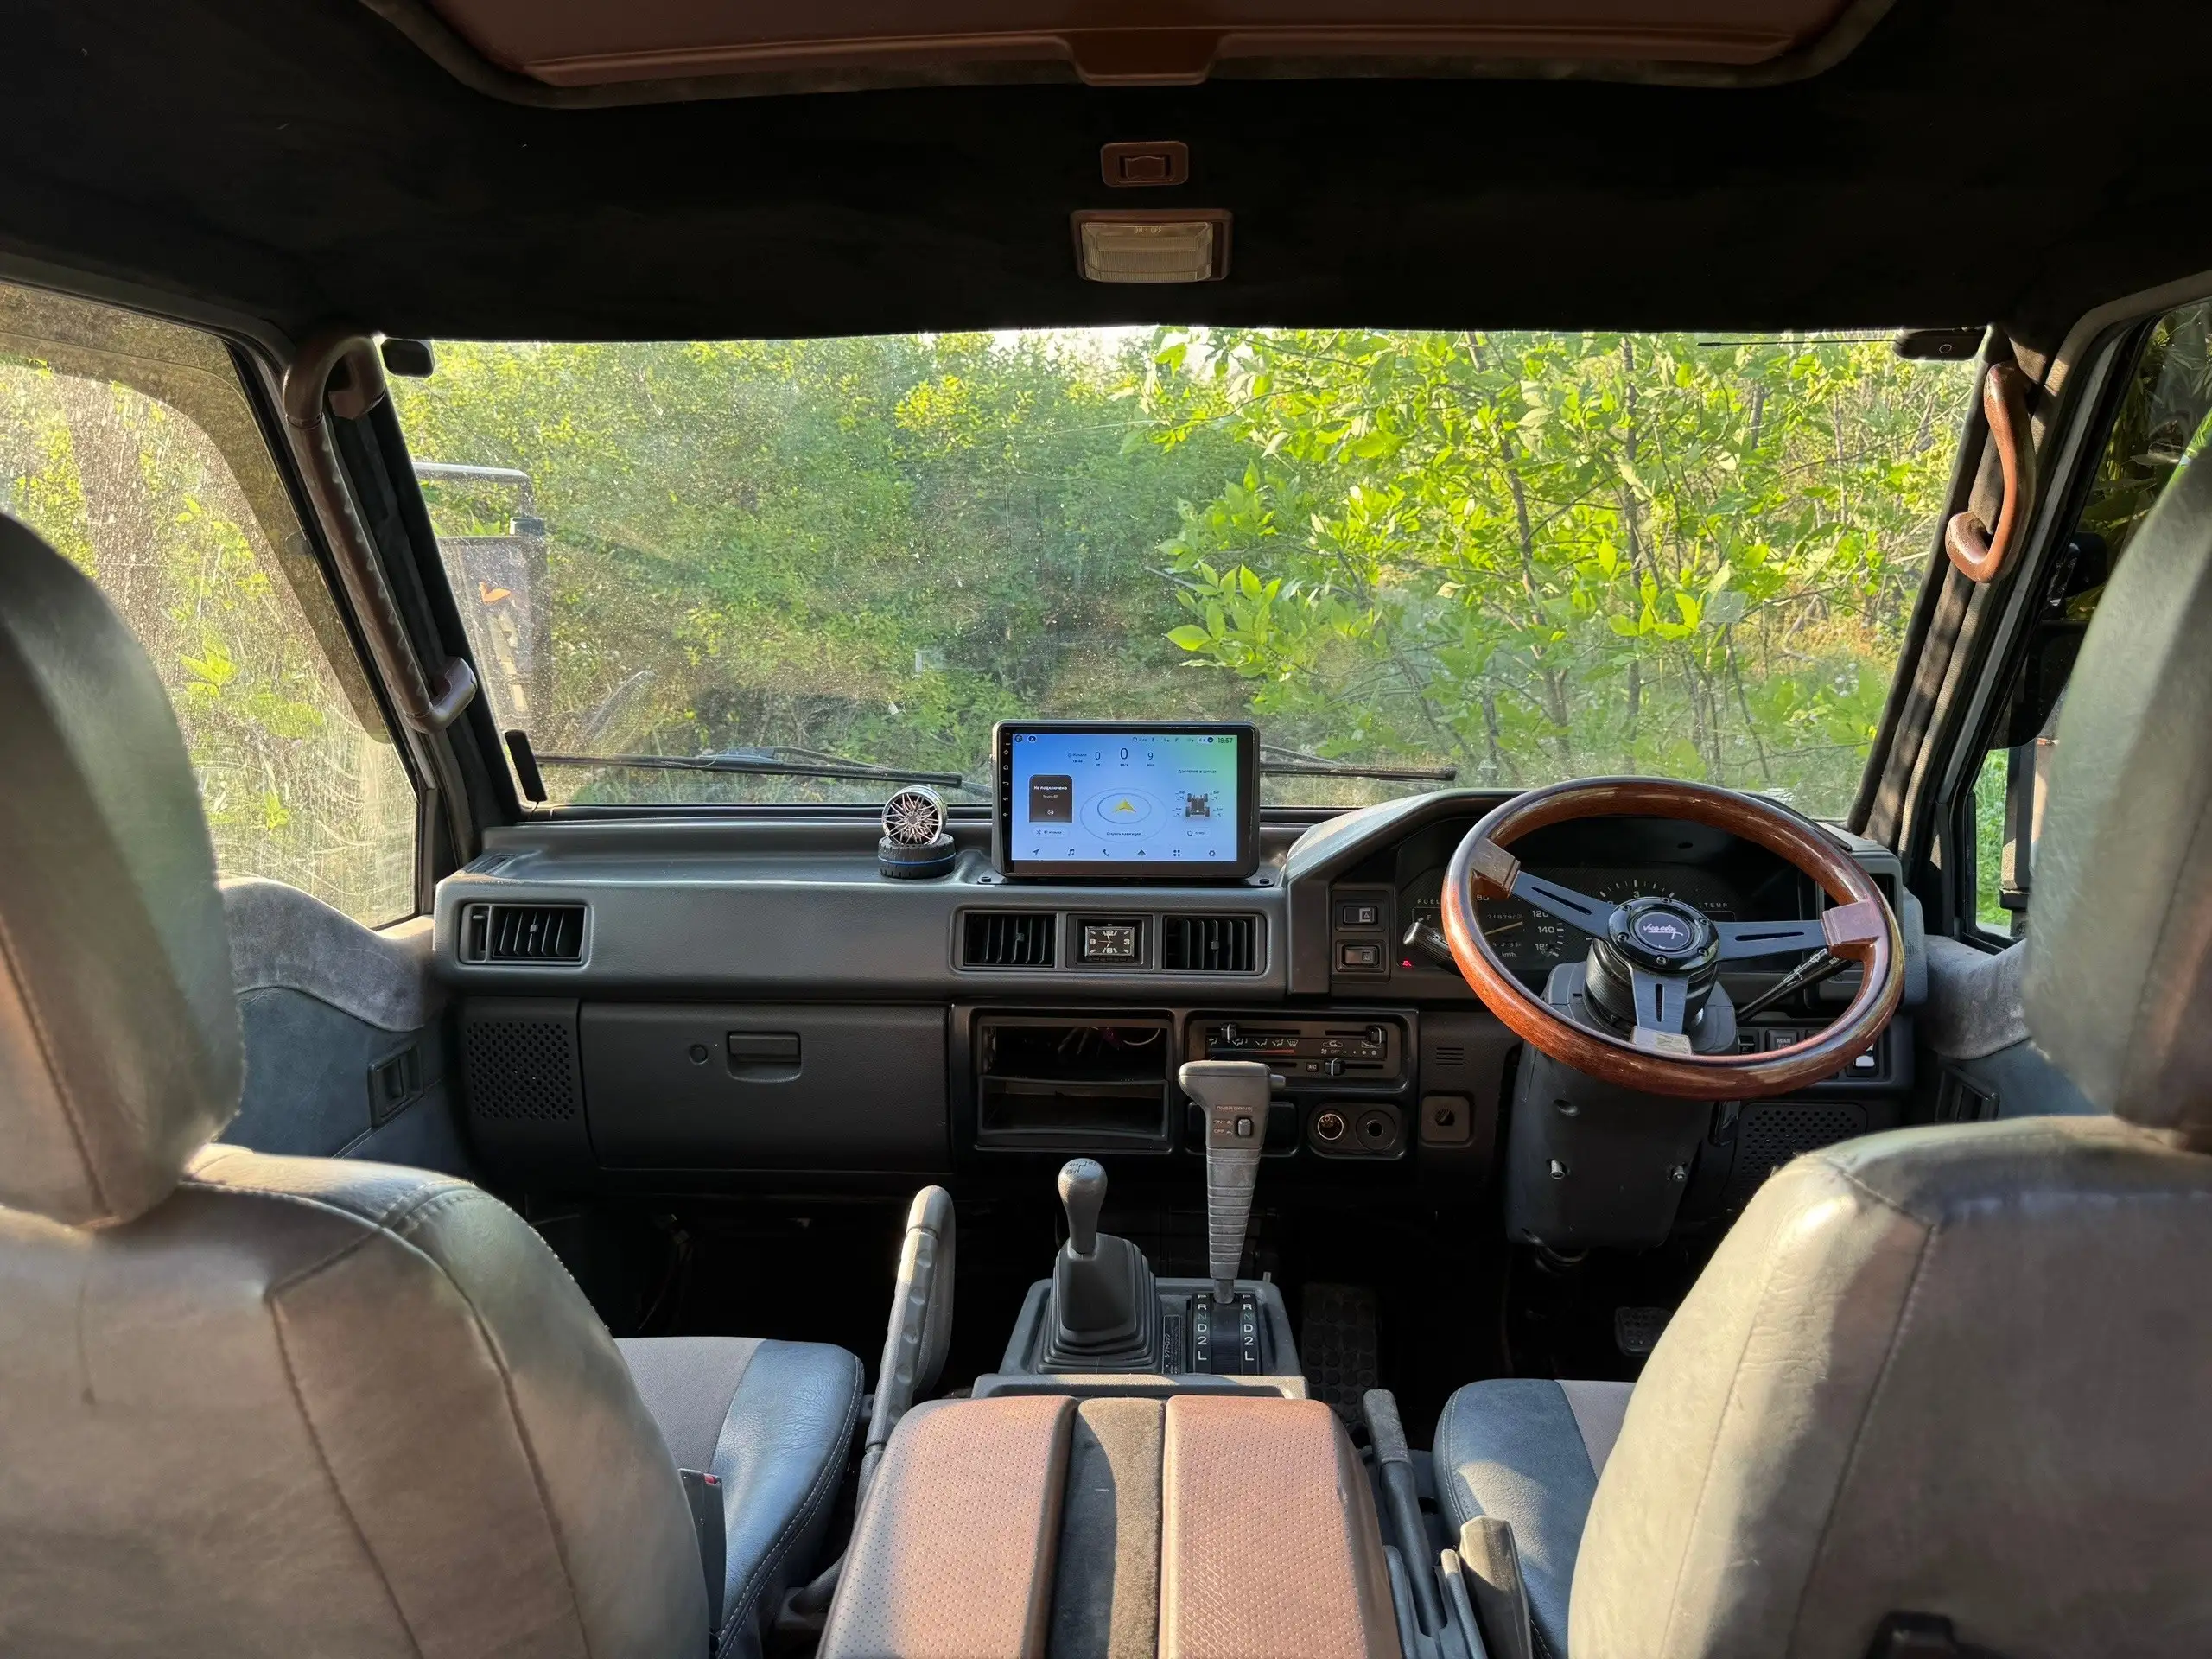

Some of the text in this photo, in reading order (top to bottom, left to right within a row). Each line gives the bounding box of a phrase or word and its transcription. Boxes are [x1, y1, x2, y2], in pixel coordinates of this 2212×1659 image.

[1120, 747, 1128, 760] 0
[1147, 752, 1154, 760] 9
[1244, 1324, 1254, 1332] D
[1198, 1336, 1207, 1345] 2
[1244, 1336, 1254, 1345] 2
[1198, 1351, 1207, 1361] L
[1244, 1351, 1255, 1361] L
